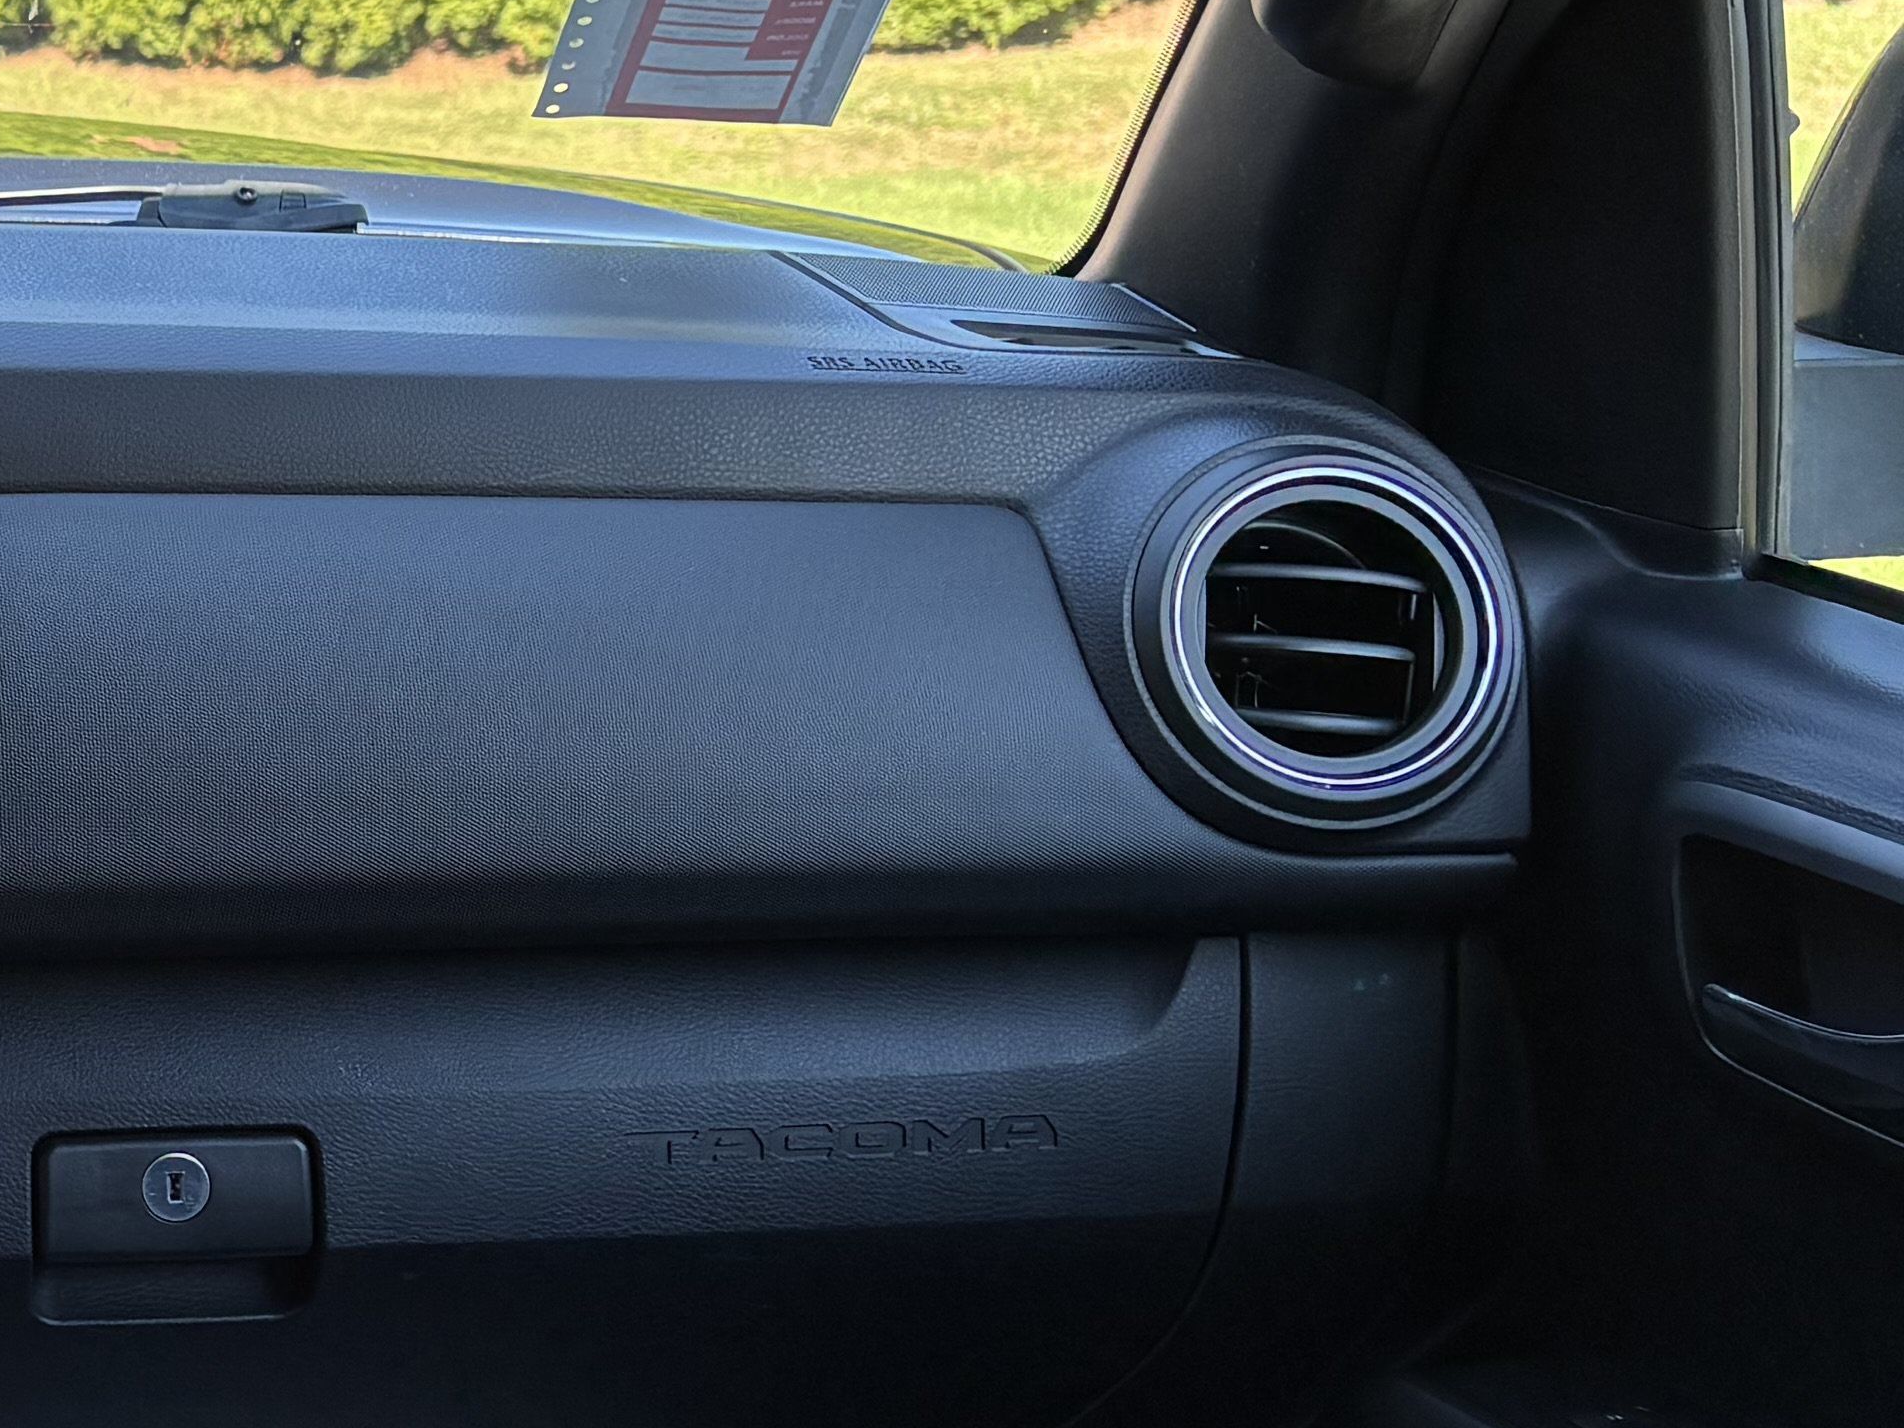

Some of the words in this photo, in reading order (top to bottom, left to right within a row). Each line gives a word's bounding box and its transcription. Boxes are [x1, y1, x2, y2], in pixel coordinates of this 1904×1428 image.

[807, 355, 855, 371] SRS
[863, 357, 965, 373] AIRBAG
[624, 1112, 1061, 1166] TACOMA
